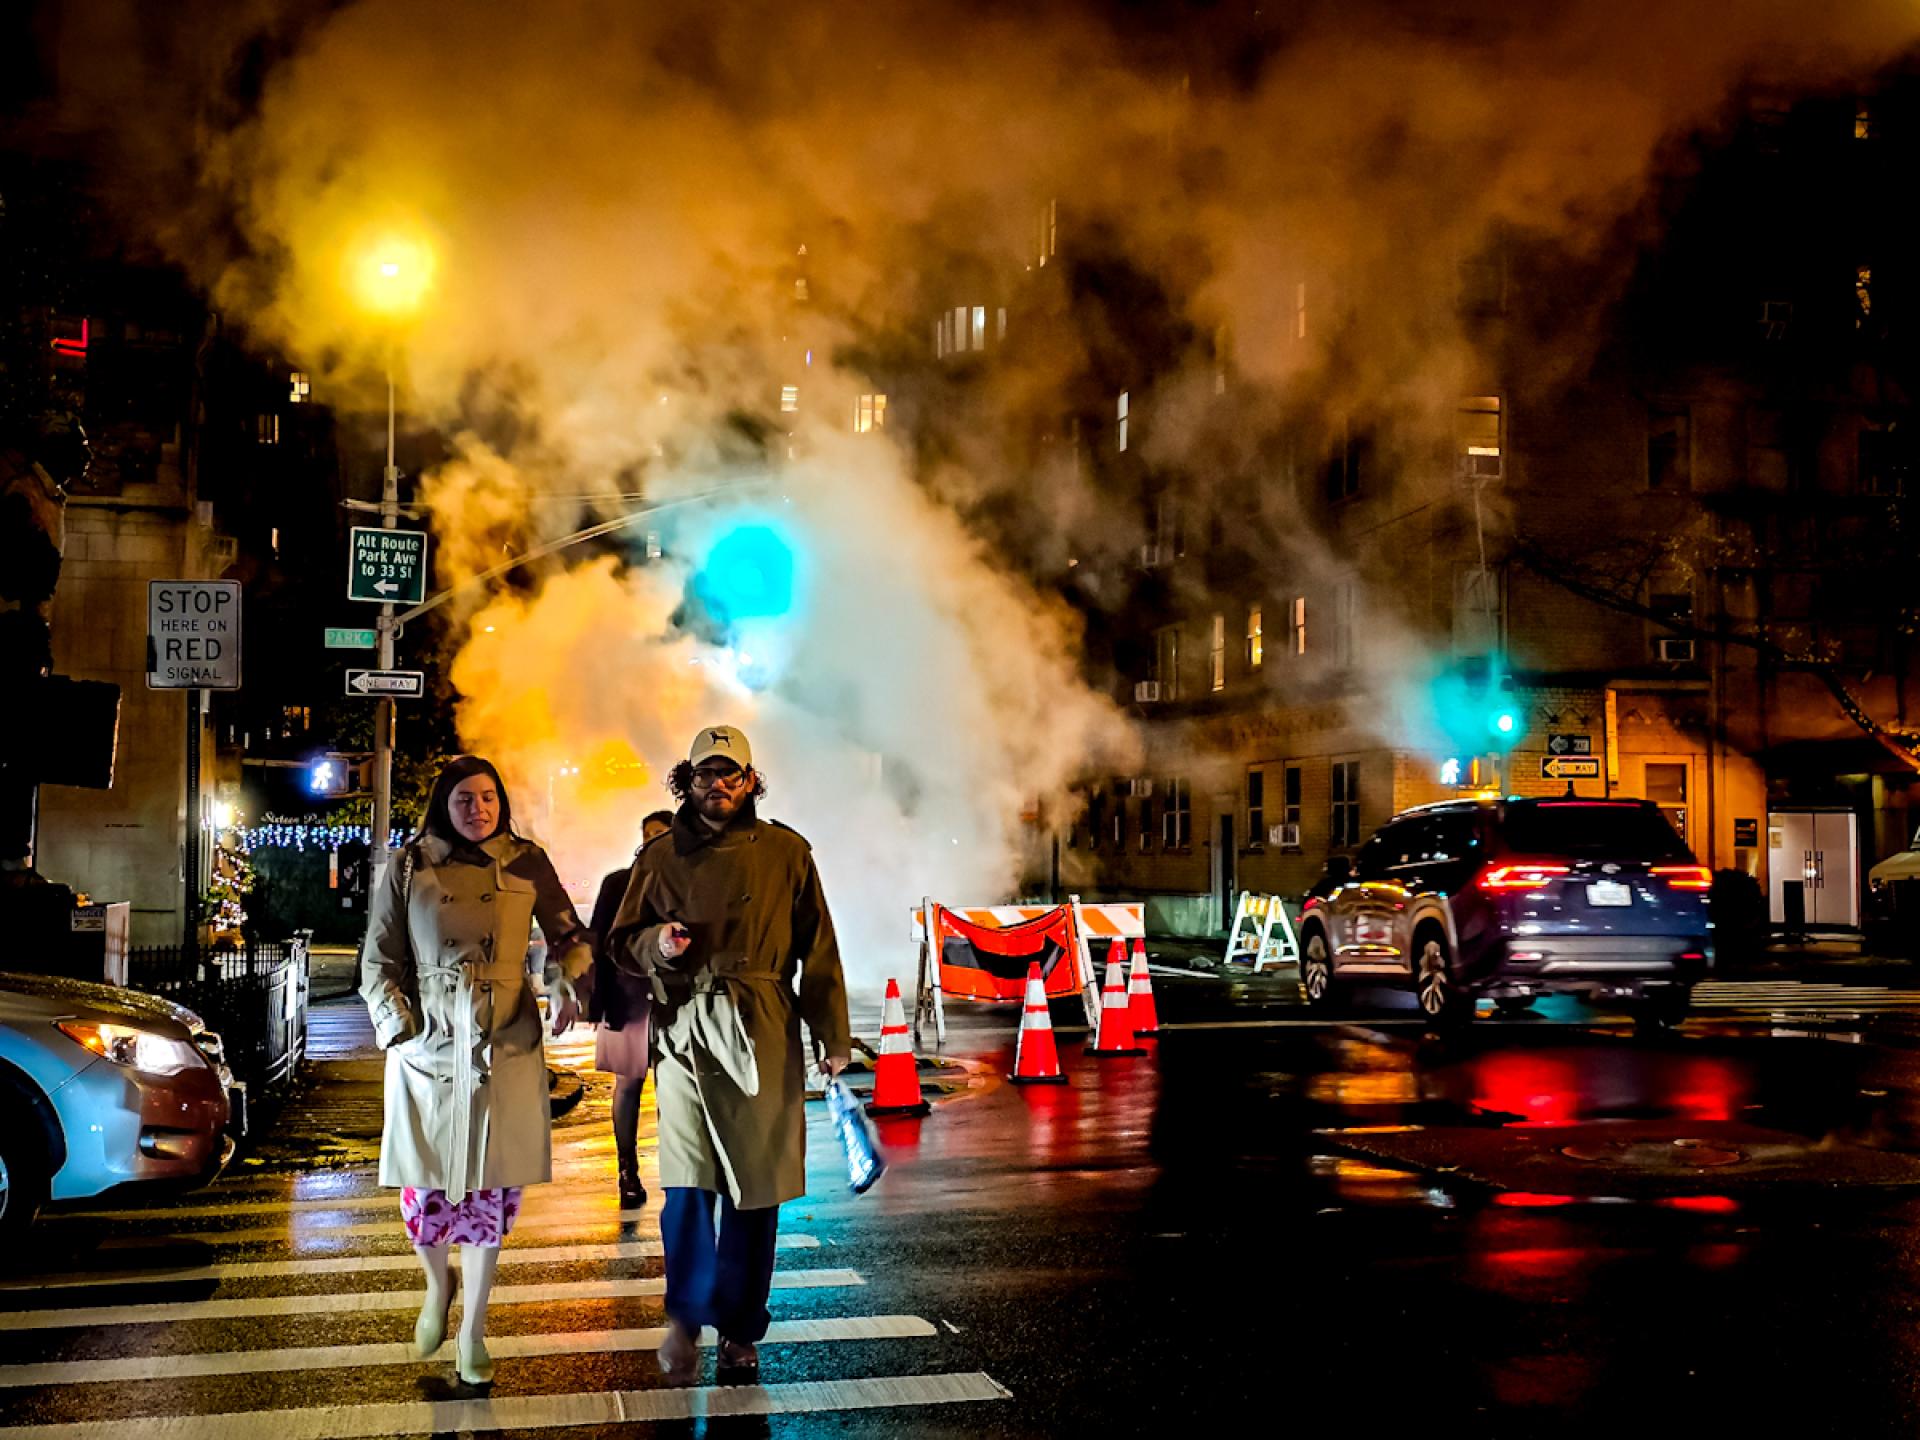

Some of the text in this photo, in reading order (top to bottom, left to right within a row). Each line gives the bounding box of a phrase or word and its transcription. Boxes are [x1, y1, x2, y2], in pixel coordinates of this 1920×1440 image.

[357, 535, 419, 551] Alt Route
[358, 548, 417, 565] Park Ave
[361, 563, 412, 578] to 33 St
[158, 590, 231, 613] STOP
[161, 619, 227, 632] HERE ON
[327, 631, 361, 644] PARK
[166, 638, 222, 661] RED
[167, 666, 222, 679] SIGNAL
[359, 678, 413, 689] ONE WAY
[1550, 764, 1593, 772] ONE WAY
